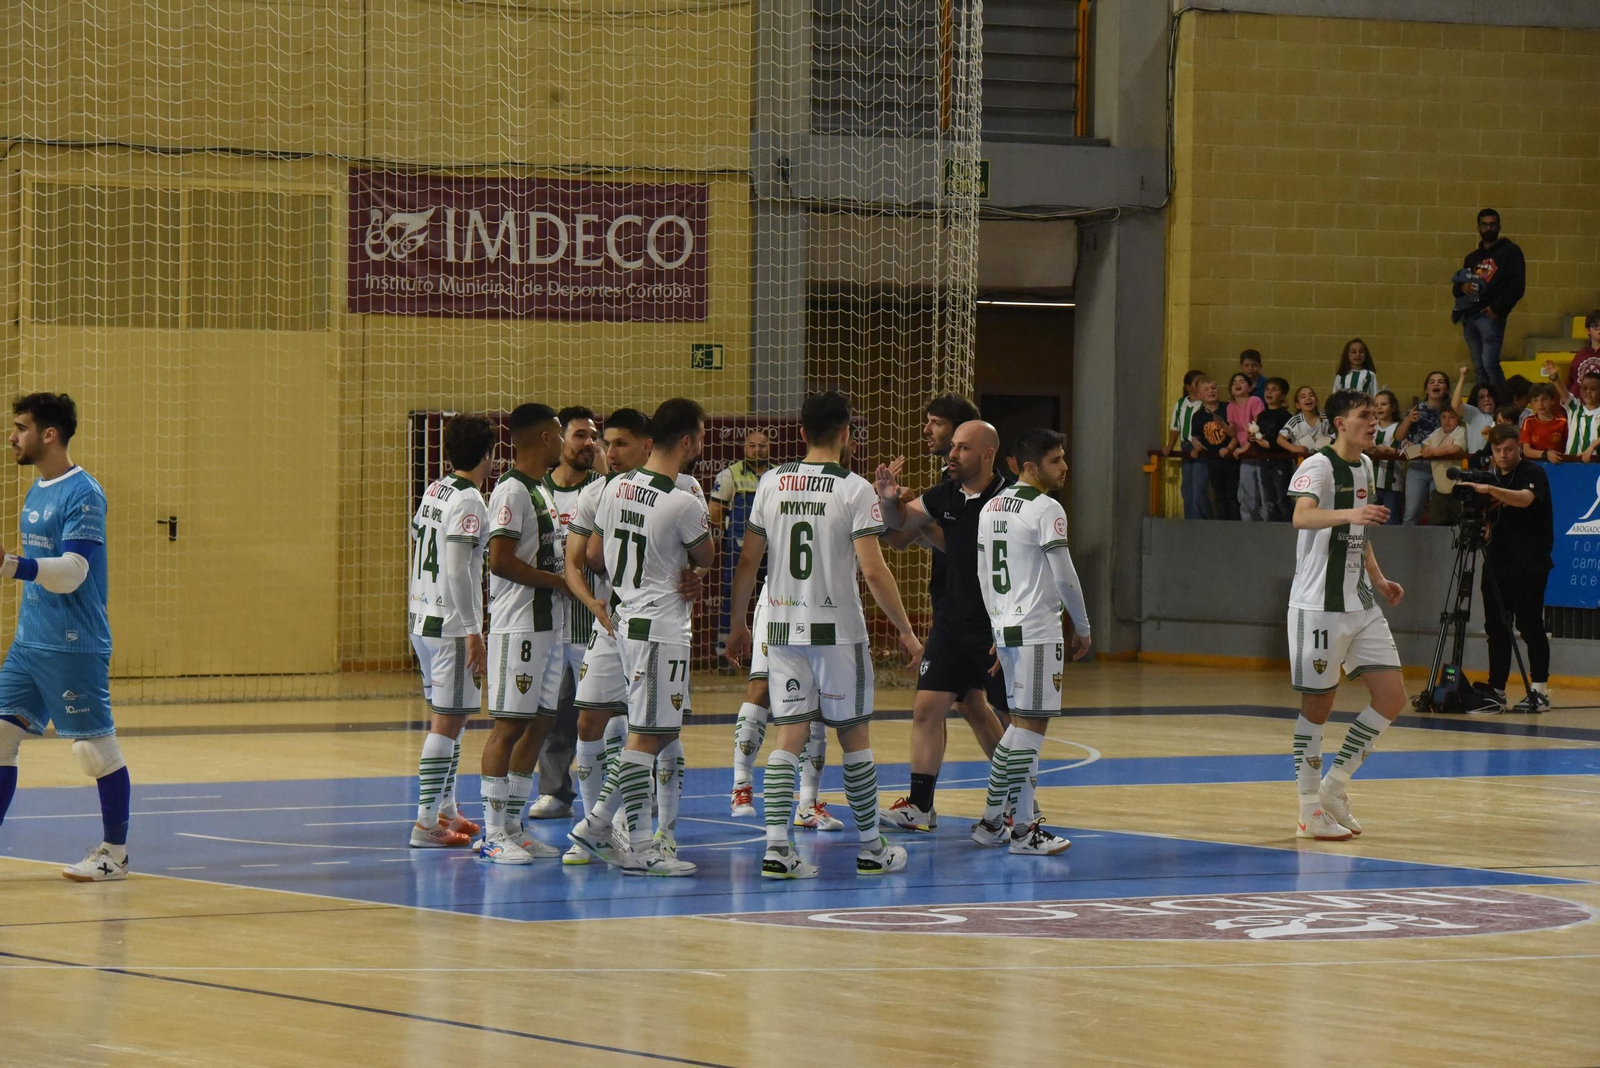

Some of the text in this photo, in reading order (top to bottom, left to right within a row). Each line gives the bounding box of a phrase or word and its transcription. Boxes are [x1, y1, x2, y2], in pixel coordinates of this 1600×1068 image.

[444, 206, 694, 270] IMDECO
[365, 272, 434, 293] Instituto
[439, 276, 518, 297] Municipal
[522, 280, 543, 296] de
[548, 281, 621, 301] Deportes
[993, 520, 1008, 534] LLUC
[417, 524, 440, 583] 14
[613, 528, 647, 588] 77
[789, 521, 814, 581] 6
[992, 539, 1012, 595] 5
[521, 639, 532, 662] 8
[587, 629, 598, 651] 0
[1055, 643, 1063, 661] 5
[1312, 629, 1329, 649] 11
[668, 659, 687, 682] 77
